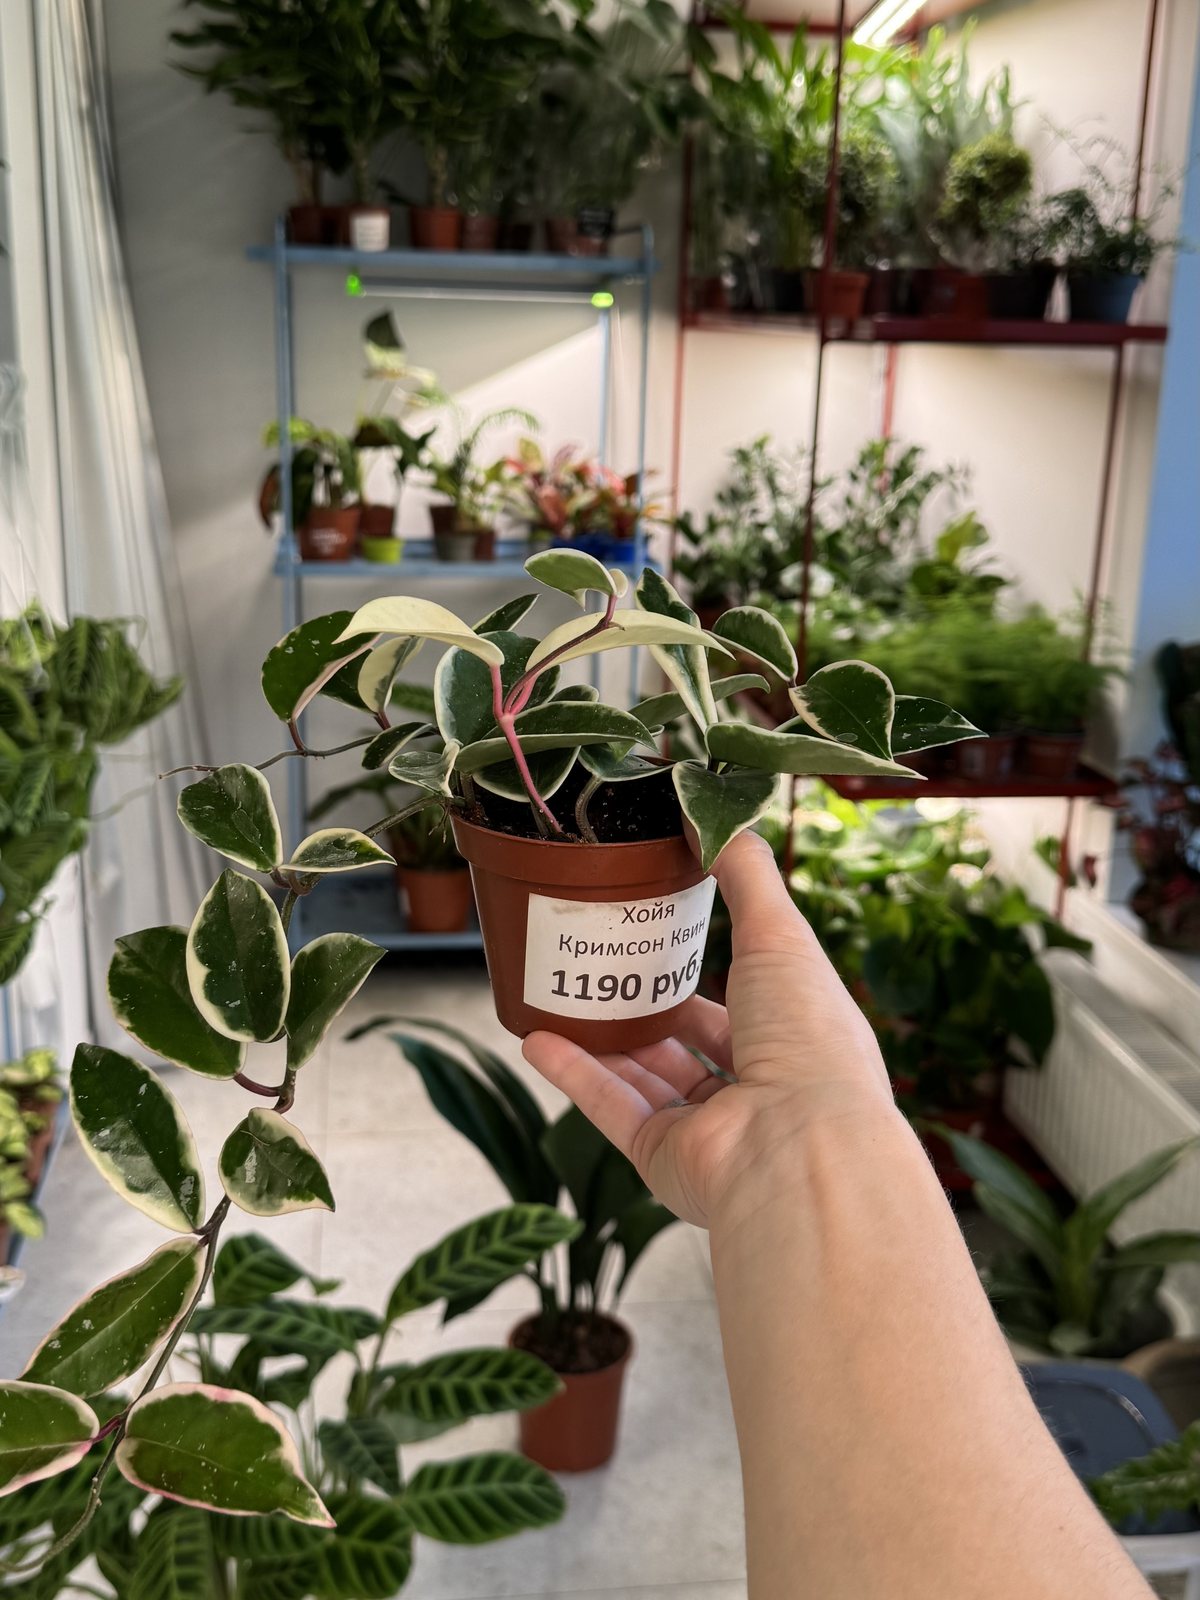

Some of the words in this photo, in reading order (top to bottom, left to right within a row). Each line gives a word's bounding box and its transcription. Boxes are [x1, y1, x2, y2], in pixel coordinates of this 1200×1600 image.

[621, 900, 675, 924] Хойя
[559, 933, 664, 958] Кримсон
[671, 916, 706, 948] Квин
[551, 970, 642, 1001] 1190
